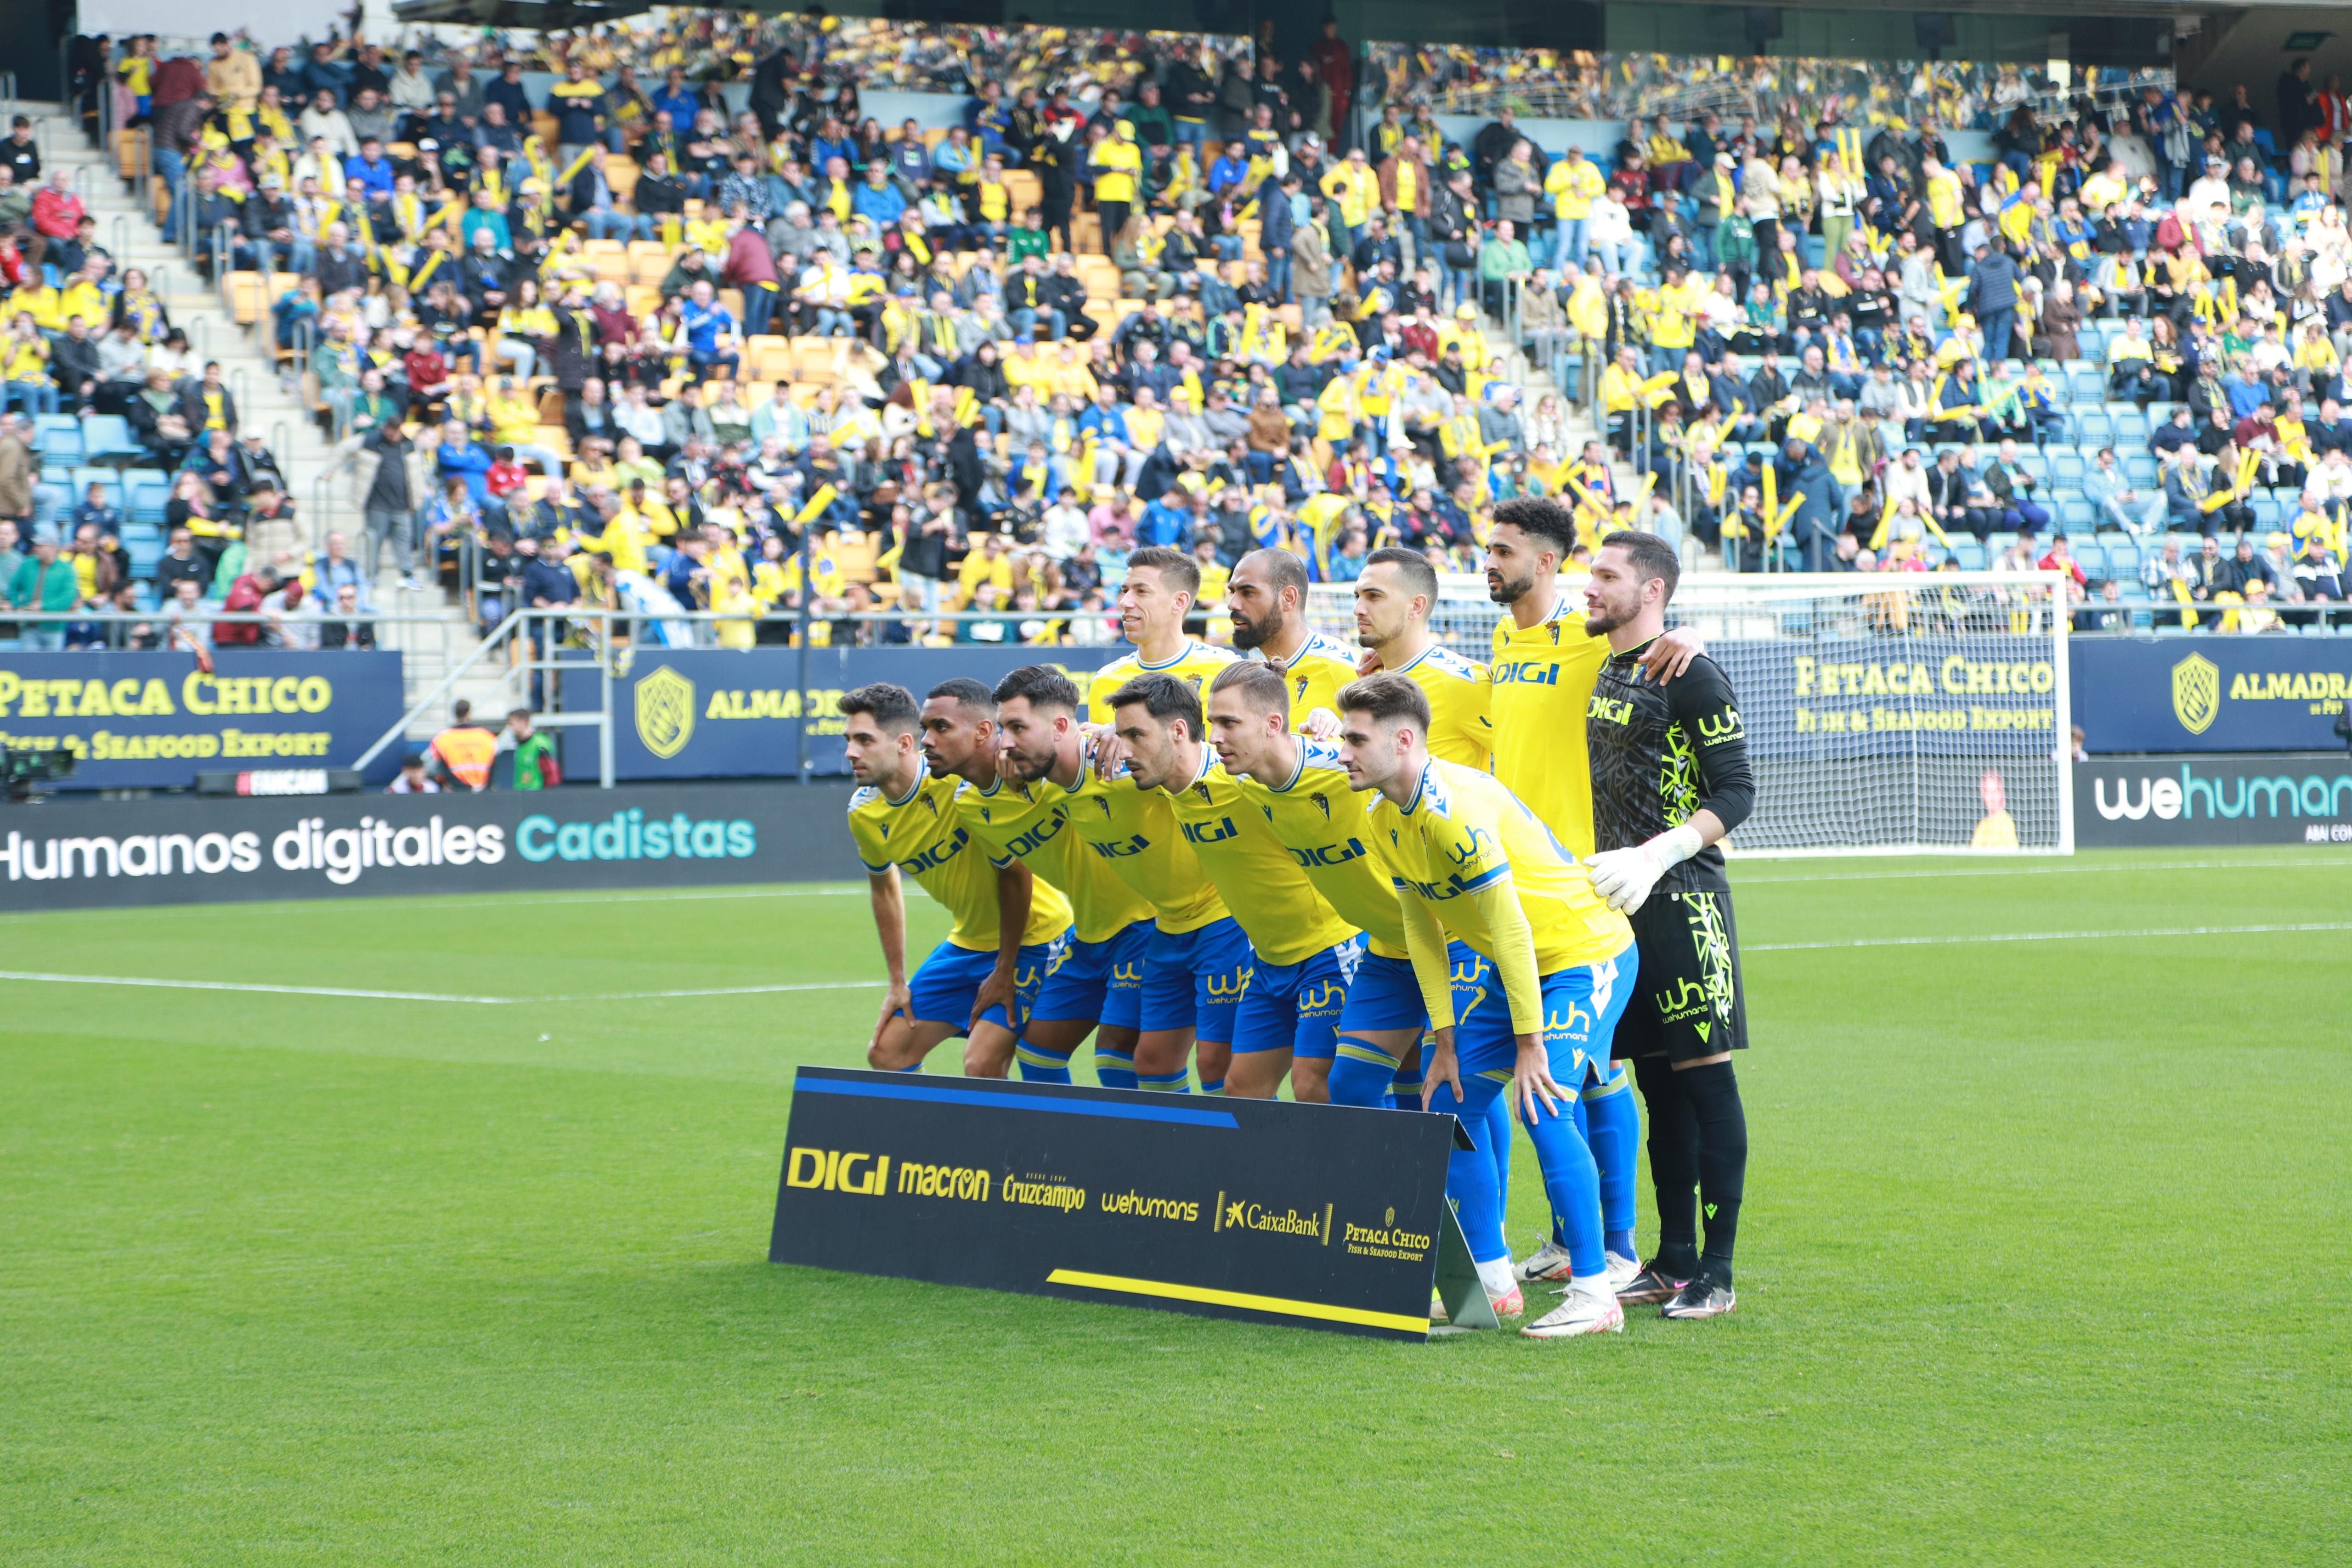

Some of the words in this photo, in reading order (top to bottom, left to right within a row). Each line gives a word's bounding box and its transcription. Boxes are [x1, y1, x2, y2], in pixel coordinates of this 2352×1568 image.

[1493, 662, 1560, 685] DIGI
[1795, 656, 1934, 695] PETACA
[1941, 654, 2054, 694] CHICO
[182, 670, 332, 715] CHICO
[1872, 705, 1967, 731] SEAFOOD
[1971, 705, 2054, 730] EXPORT
[91, 729, 220, 760] SEAFOOD
[220, 728, 332, 757] EXPORT
[0, 830, 262, 880] Humanos
[272, 815, 506, 885] digitales
[515, 807, 757, 862] Cadistas
[898, 827, 969, 874] DIGI
[1299, 980, 1346, 1010] wh
[1656, 977, 1706, 1013] wh
[1663, 1004, 1708, 1024] wehumans
[1543, 1032, 1588, 1042] ehumans
[786, 1147, 891, 1196] DIGI
[898, 1162, 990, 1202] macron
[1002, 1173, 1086, 1213] Cruzcampo
[1101, 1189, 1199, 1222] wehumans
[1247, 1204, 1320, 1237] CaixaBank
[1345, 1223, 1389, 1246] PETACA
[1392, 1228, 1430, 1250] CHICO
[1347, 1244, 1363, 1254] FISH
[1363, 1246, 1368, 1255] &
[1369, 1246, 1397, 1258] SEAFOOD
[1398, 1250, 1424, 1262] EXPORT
